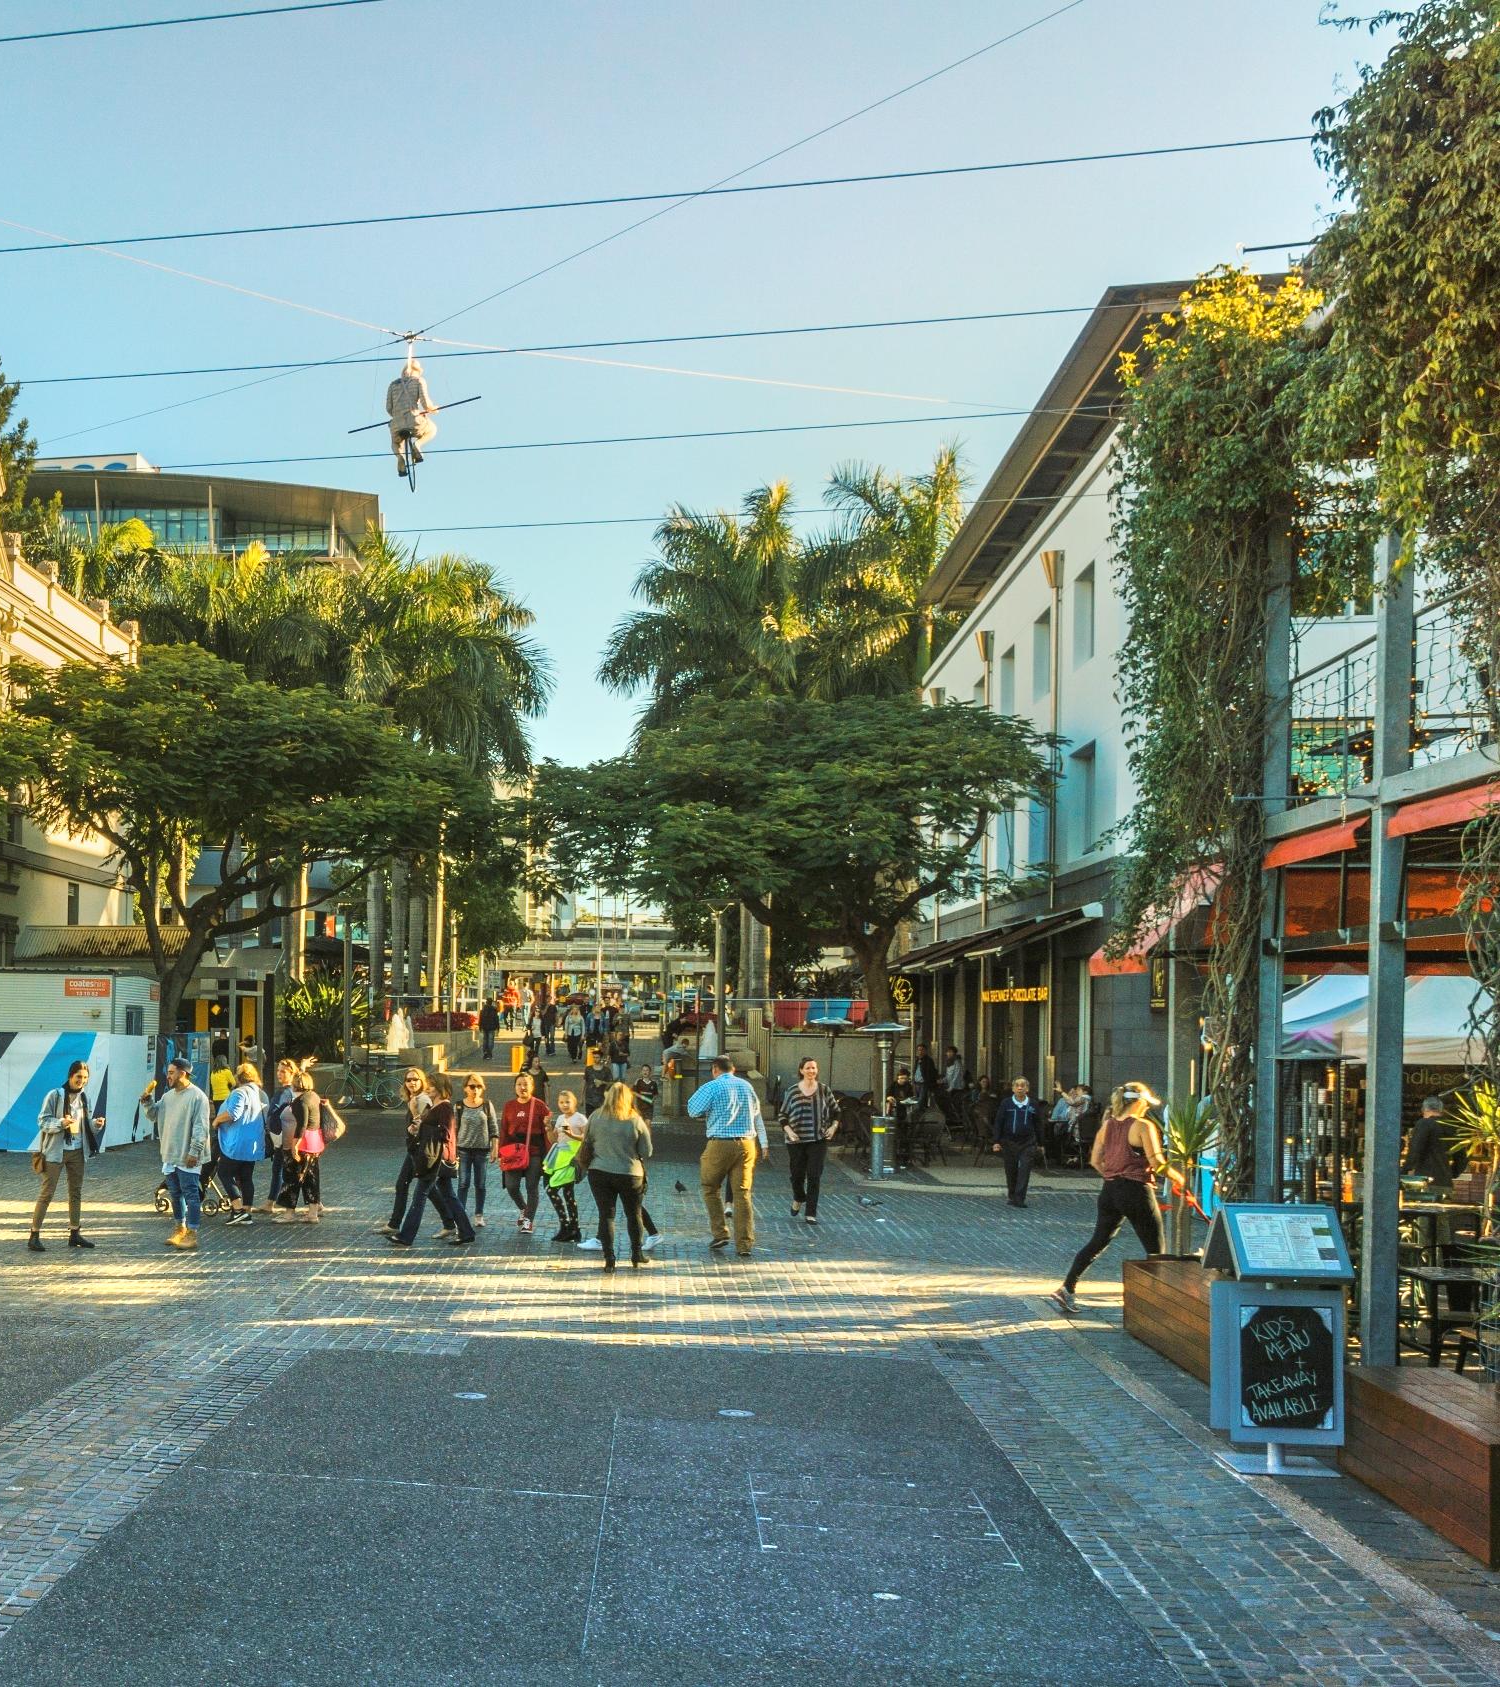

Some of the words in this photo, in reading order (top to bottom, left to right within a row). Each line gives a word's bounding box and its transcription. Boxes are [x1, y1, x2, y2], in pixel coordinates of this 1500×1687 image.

[1037, 986, 1048, 1001] BAR
[1249, 1315, 1294, 1342] KIDS
[1264, 1328, 1311, 1361] MENU
[1245, 1368, 1318, 1400] TAKEAWAY
[1251, 1393, 1321, 1422] AVAILABLE
